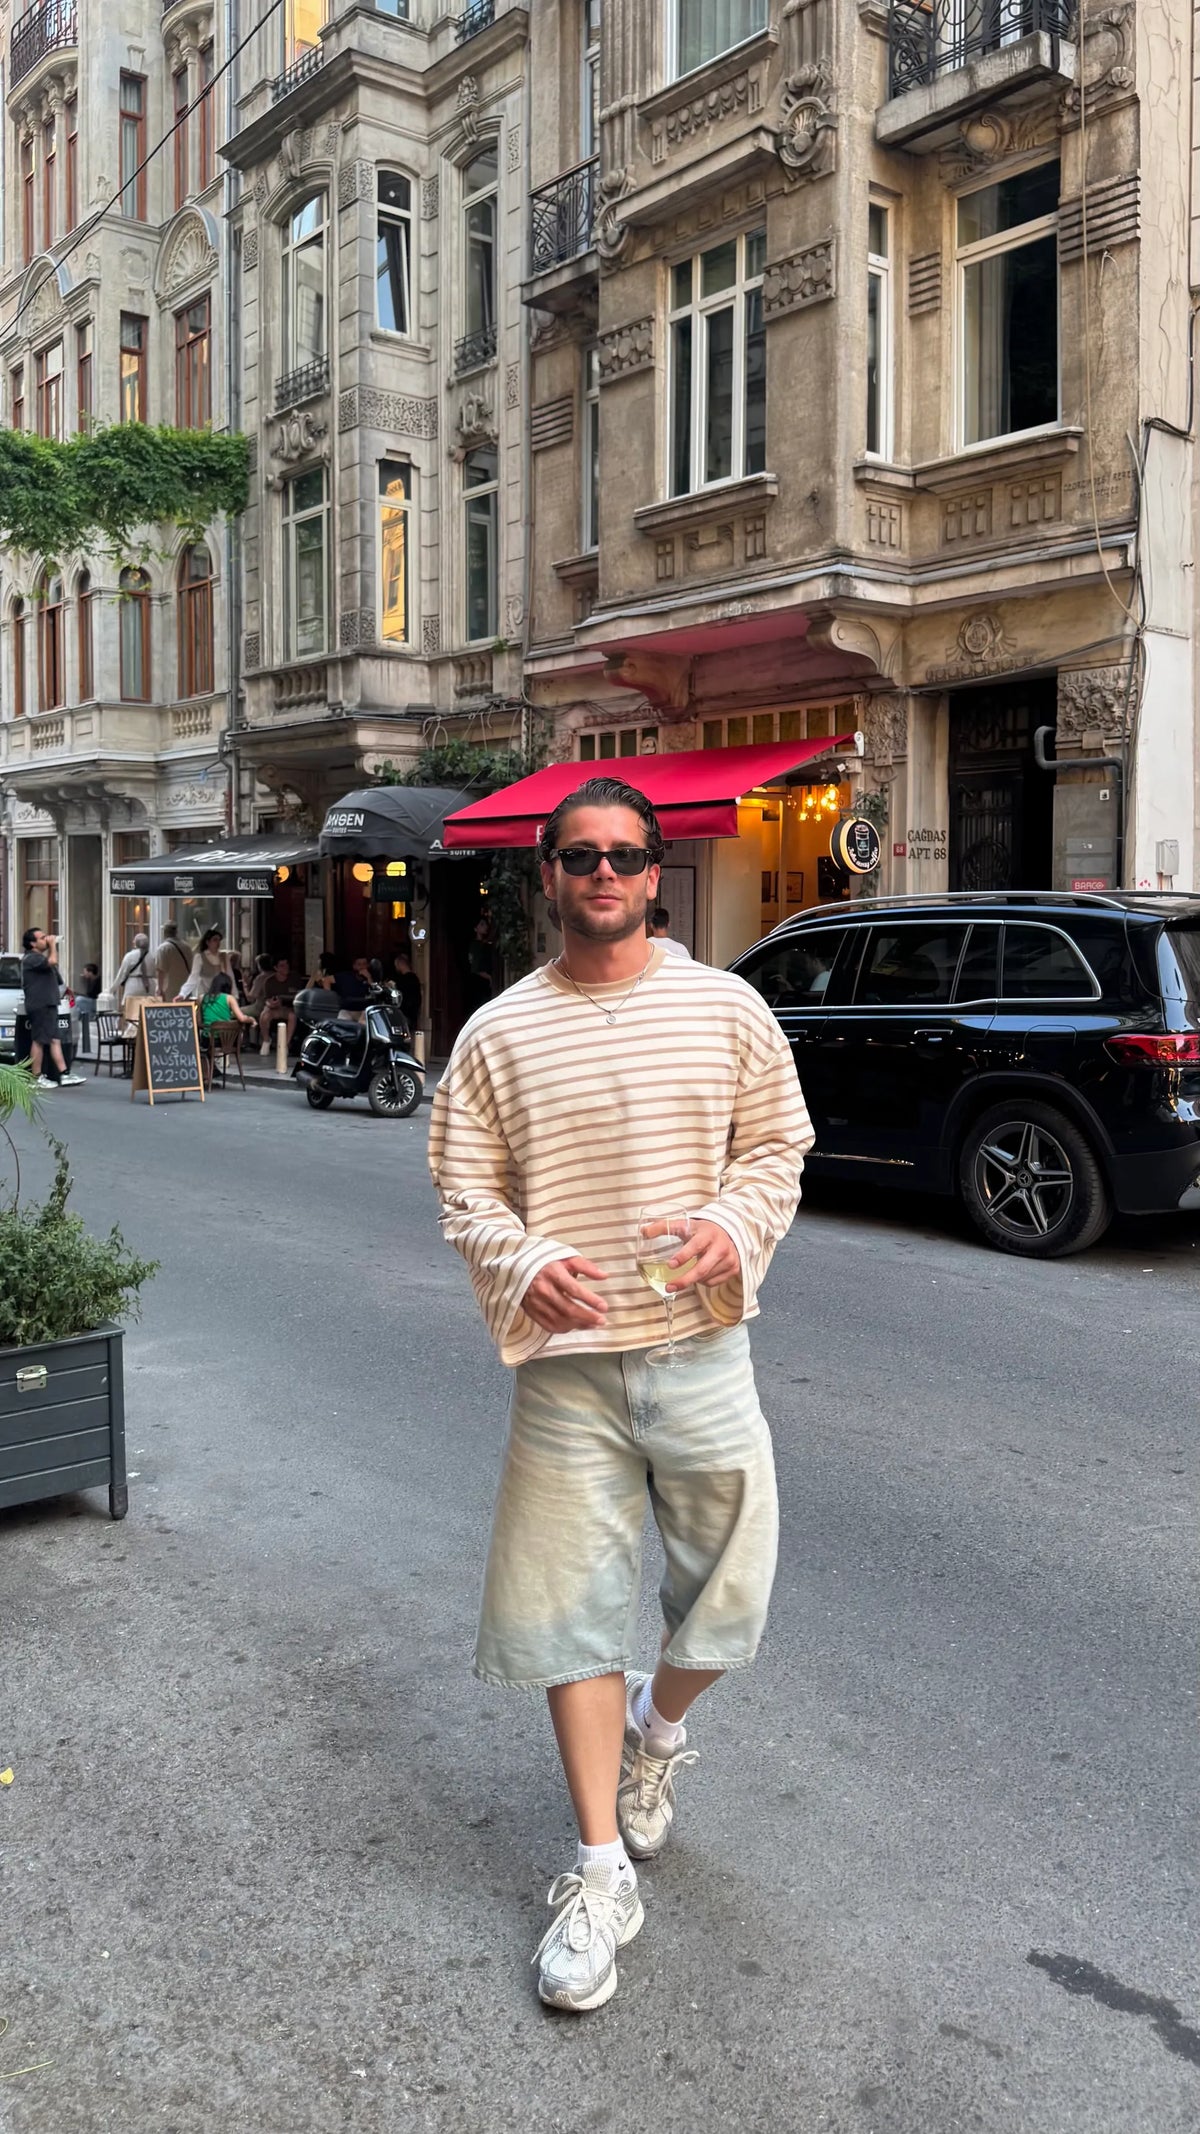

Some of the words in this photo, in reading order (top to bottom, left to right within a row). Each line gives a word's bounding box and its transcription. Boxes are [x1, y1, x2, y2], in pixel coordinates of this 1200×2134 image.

[907, 829, 947, 844] ÇAĞDAŞ
[933, 847, 947, 860] 68
[146, 1007, 190, 1019] WORLD
[149, 1030, 189, 1043] SPAIN
[151, 1054, 198, 1067] AUSTRIA
[153, 1068, 198, 1083] 22:00
